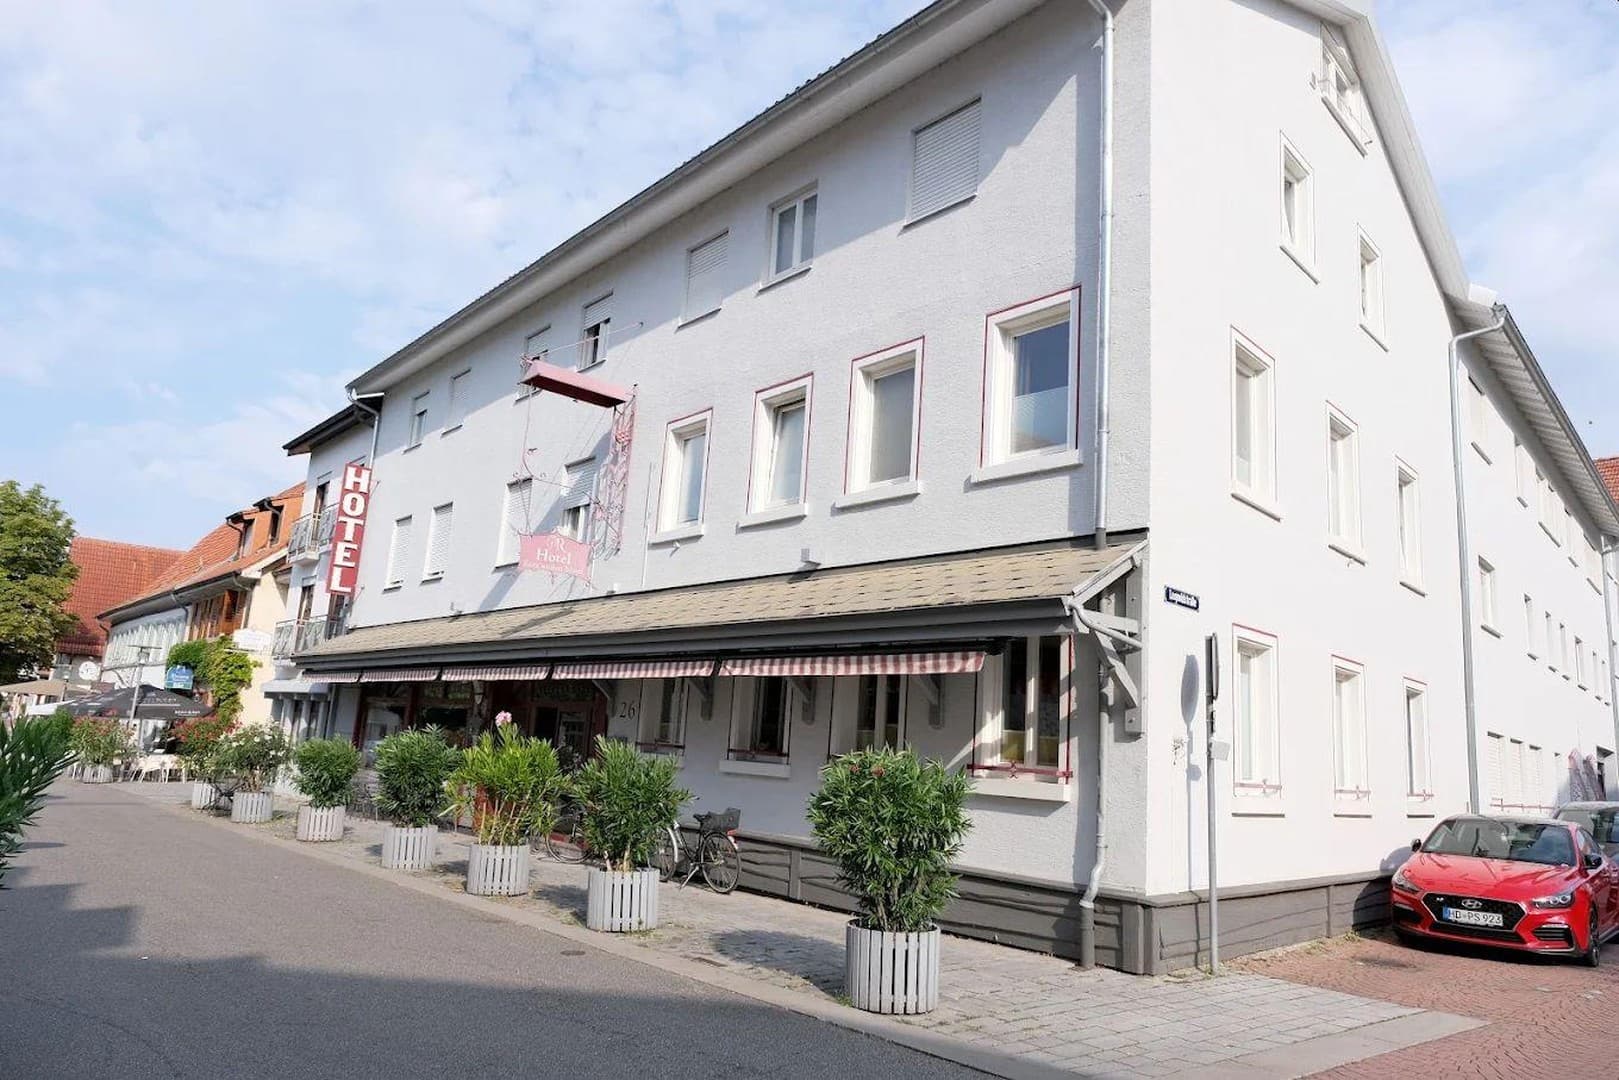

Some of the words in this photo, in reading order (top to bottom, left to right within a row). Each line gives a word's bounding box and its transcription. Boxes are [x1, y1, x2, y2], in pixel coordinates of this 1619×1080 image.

[331, 467, 371, 593] HOTEL
[536, 548, 571, 565] Hotel
[619, 701, 636, 720] 26
[1482, 914, 1502, 924] 923
